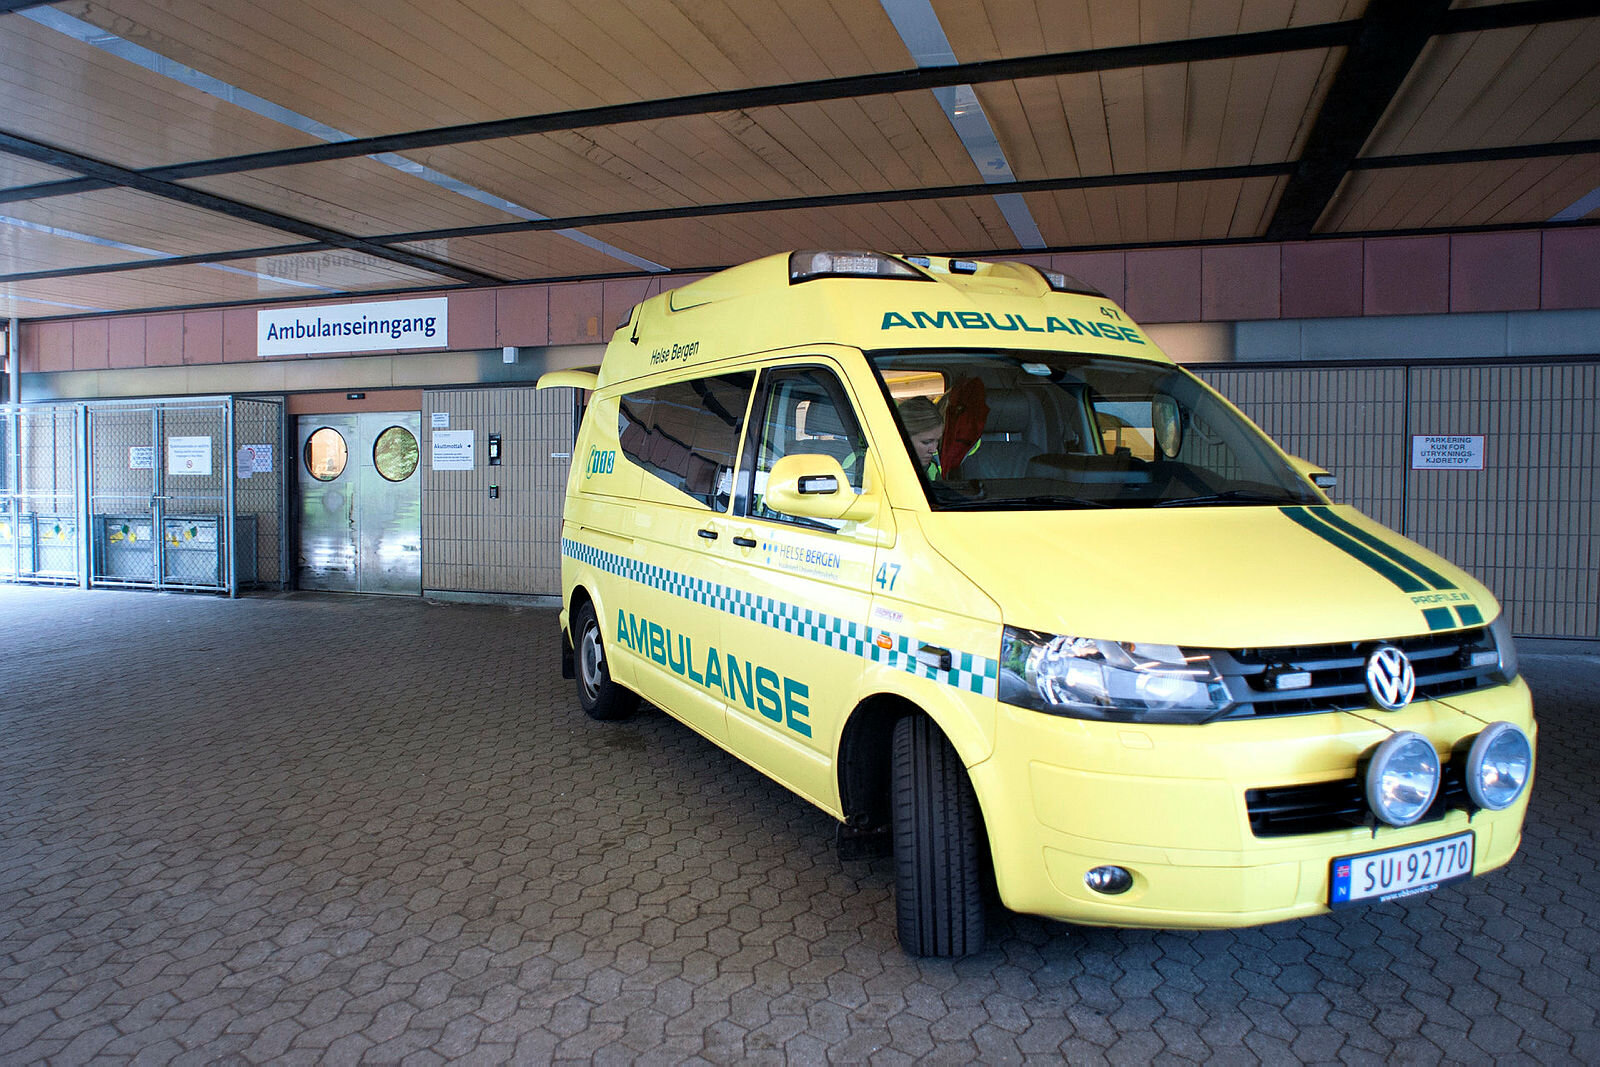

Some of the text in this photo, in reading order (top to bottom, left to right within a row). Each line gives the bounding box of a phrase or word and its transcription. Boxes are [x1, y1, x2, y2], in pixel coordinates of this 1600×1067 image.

[1100, 306, 1121, 321] 47
[267, 315, 437, 341] Ambulanseinngang
[880, 311, 1146, 345] AMBULANSE
[650, 341, 700, 365] Helse Bergen
[593, 450, 616, 474] 113
[780, 544, 841, 569] HELSE BERGEN
[876, 562, 902, 591] 47
[617, 608, 812, 739] AMBULANSE
[1364, 841, 1468, 892] SU 92770
